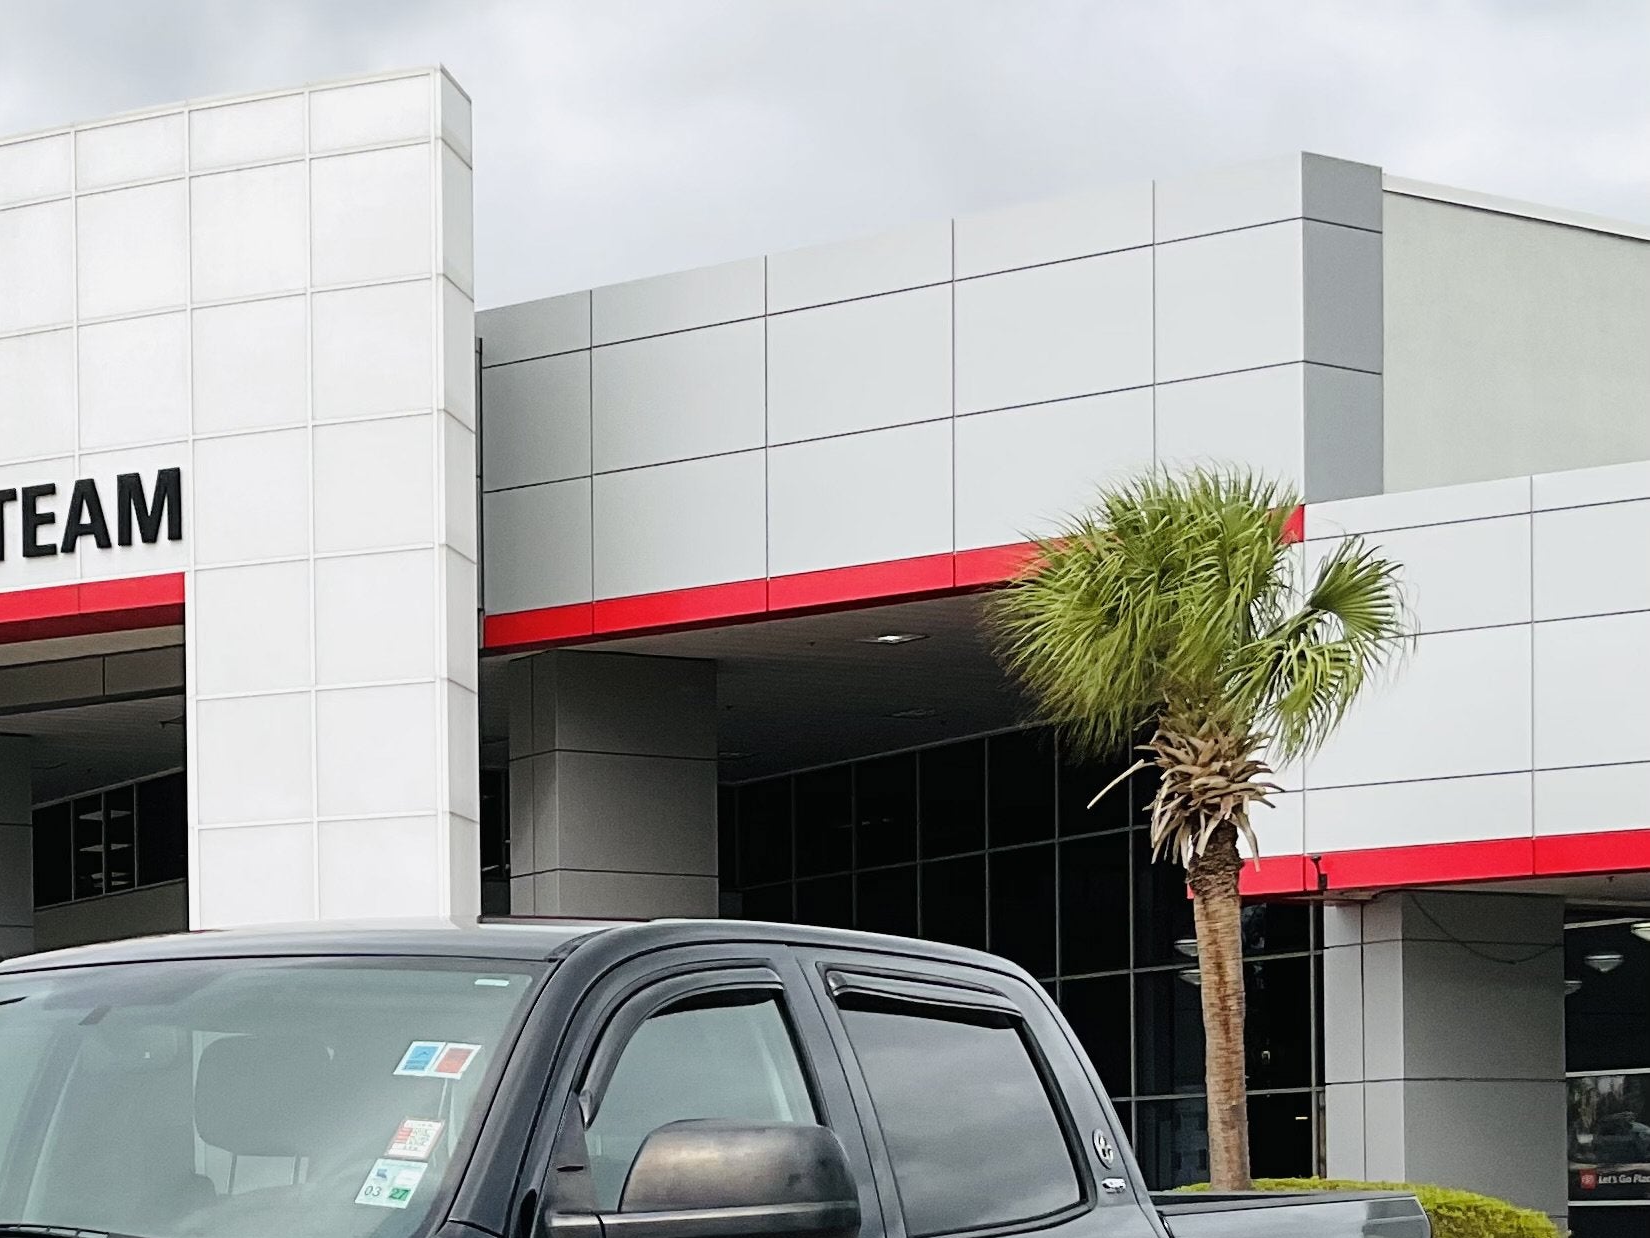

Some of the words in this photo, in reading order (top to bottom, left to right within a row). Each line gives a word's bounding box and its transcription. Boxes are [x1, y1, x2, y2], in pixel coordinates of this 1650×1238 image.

[1618, 1174, 1632, 1184] Go
[364, 1185, 382, 1197] 03
[390, 1188, 411, 1200] 27
